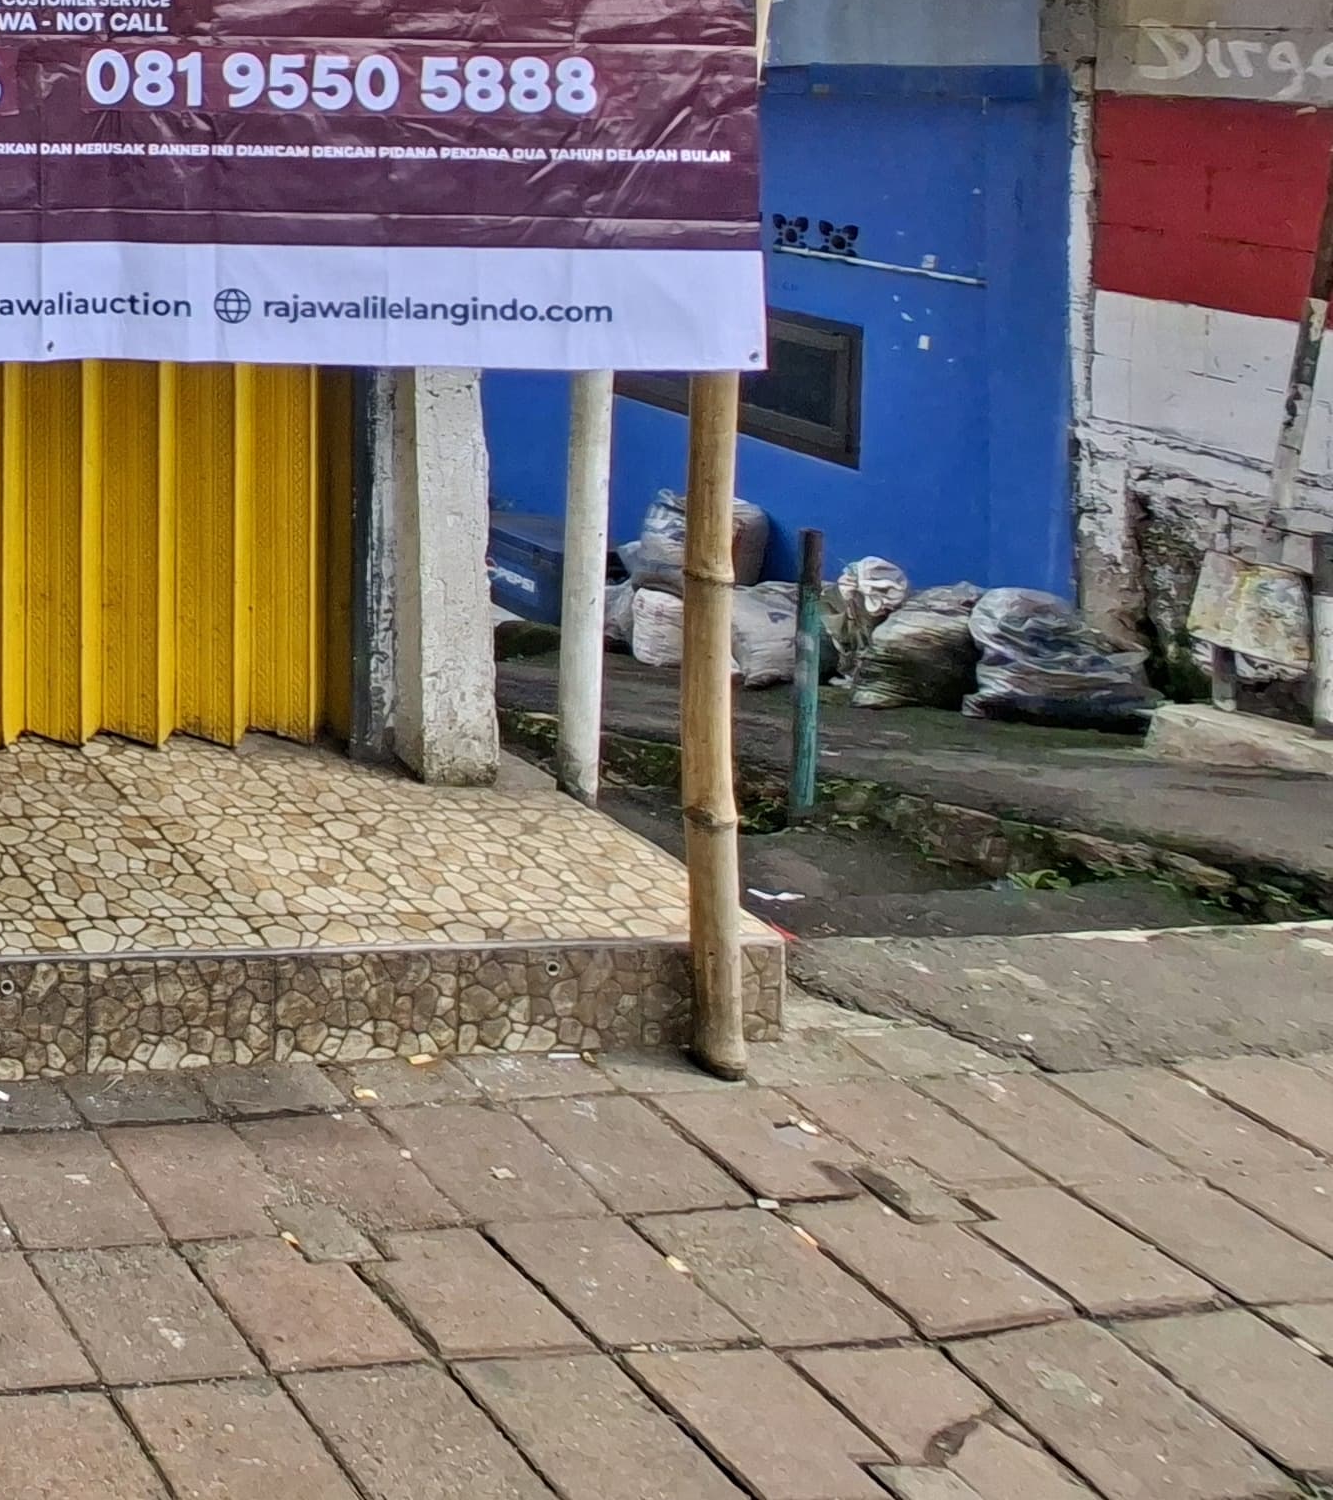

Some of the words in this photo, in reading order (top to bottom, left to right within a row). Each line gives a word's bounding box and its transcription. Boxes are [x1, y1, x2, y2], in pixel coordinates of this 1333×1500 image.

[57, 12, 104, 31] NOT
[110, 12, 168, 32] CALL
[85, 49, 202, 107] 081
[223, 51, 400, 111] 9550
[420, 56, 598, 114] 5888
[40, 142, 73, 155] DAN
[74, 142, 145, 155] MERUSAK
[148, 143, 210, 156] BANNER
[211, 144, 234, 156] INI
[236, 144, 310, 157] DIANCAM
[311, 145, 376, 158] DENGAN
[378, 146, 438, 159] PIDANA
[440, 147, 511, 161] PENJARA
[513, 148, 547, 161] DUA
[549, 148, 604, 161] TAHUN
[605, 148, 678, 162] DELAPAN
[680, 149, 731, 162] BULAN
[263, 294, 613, 327] rajawalilelangindo.com
